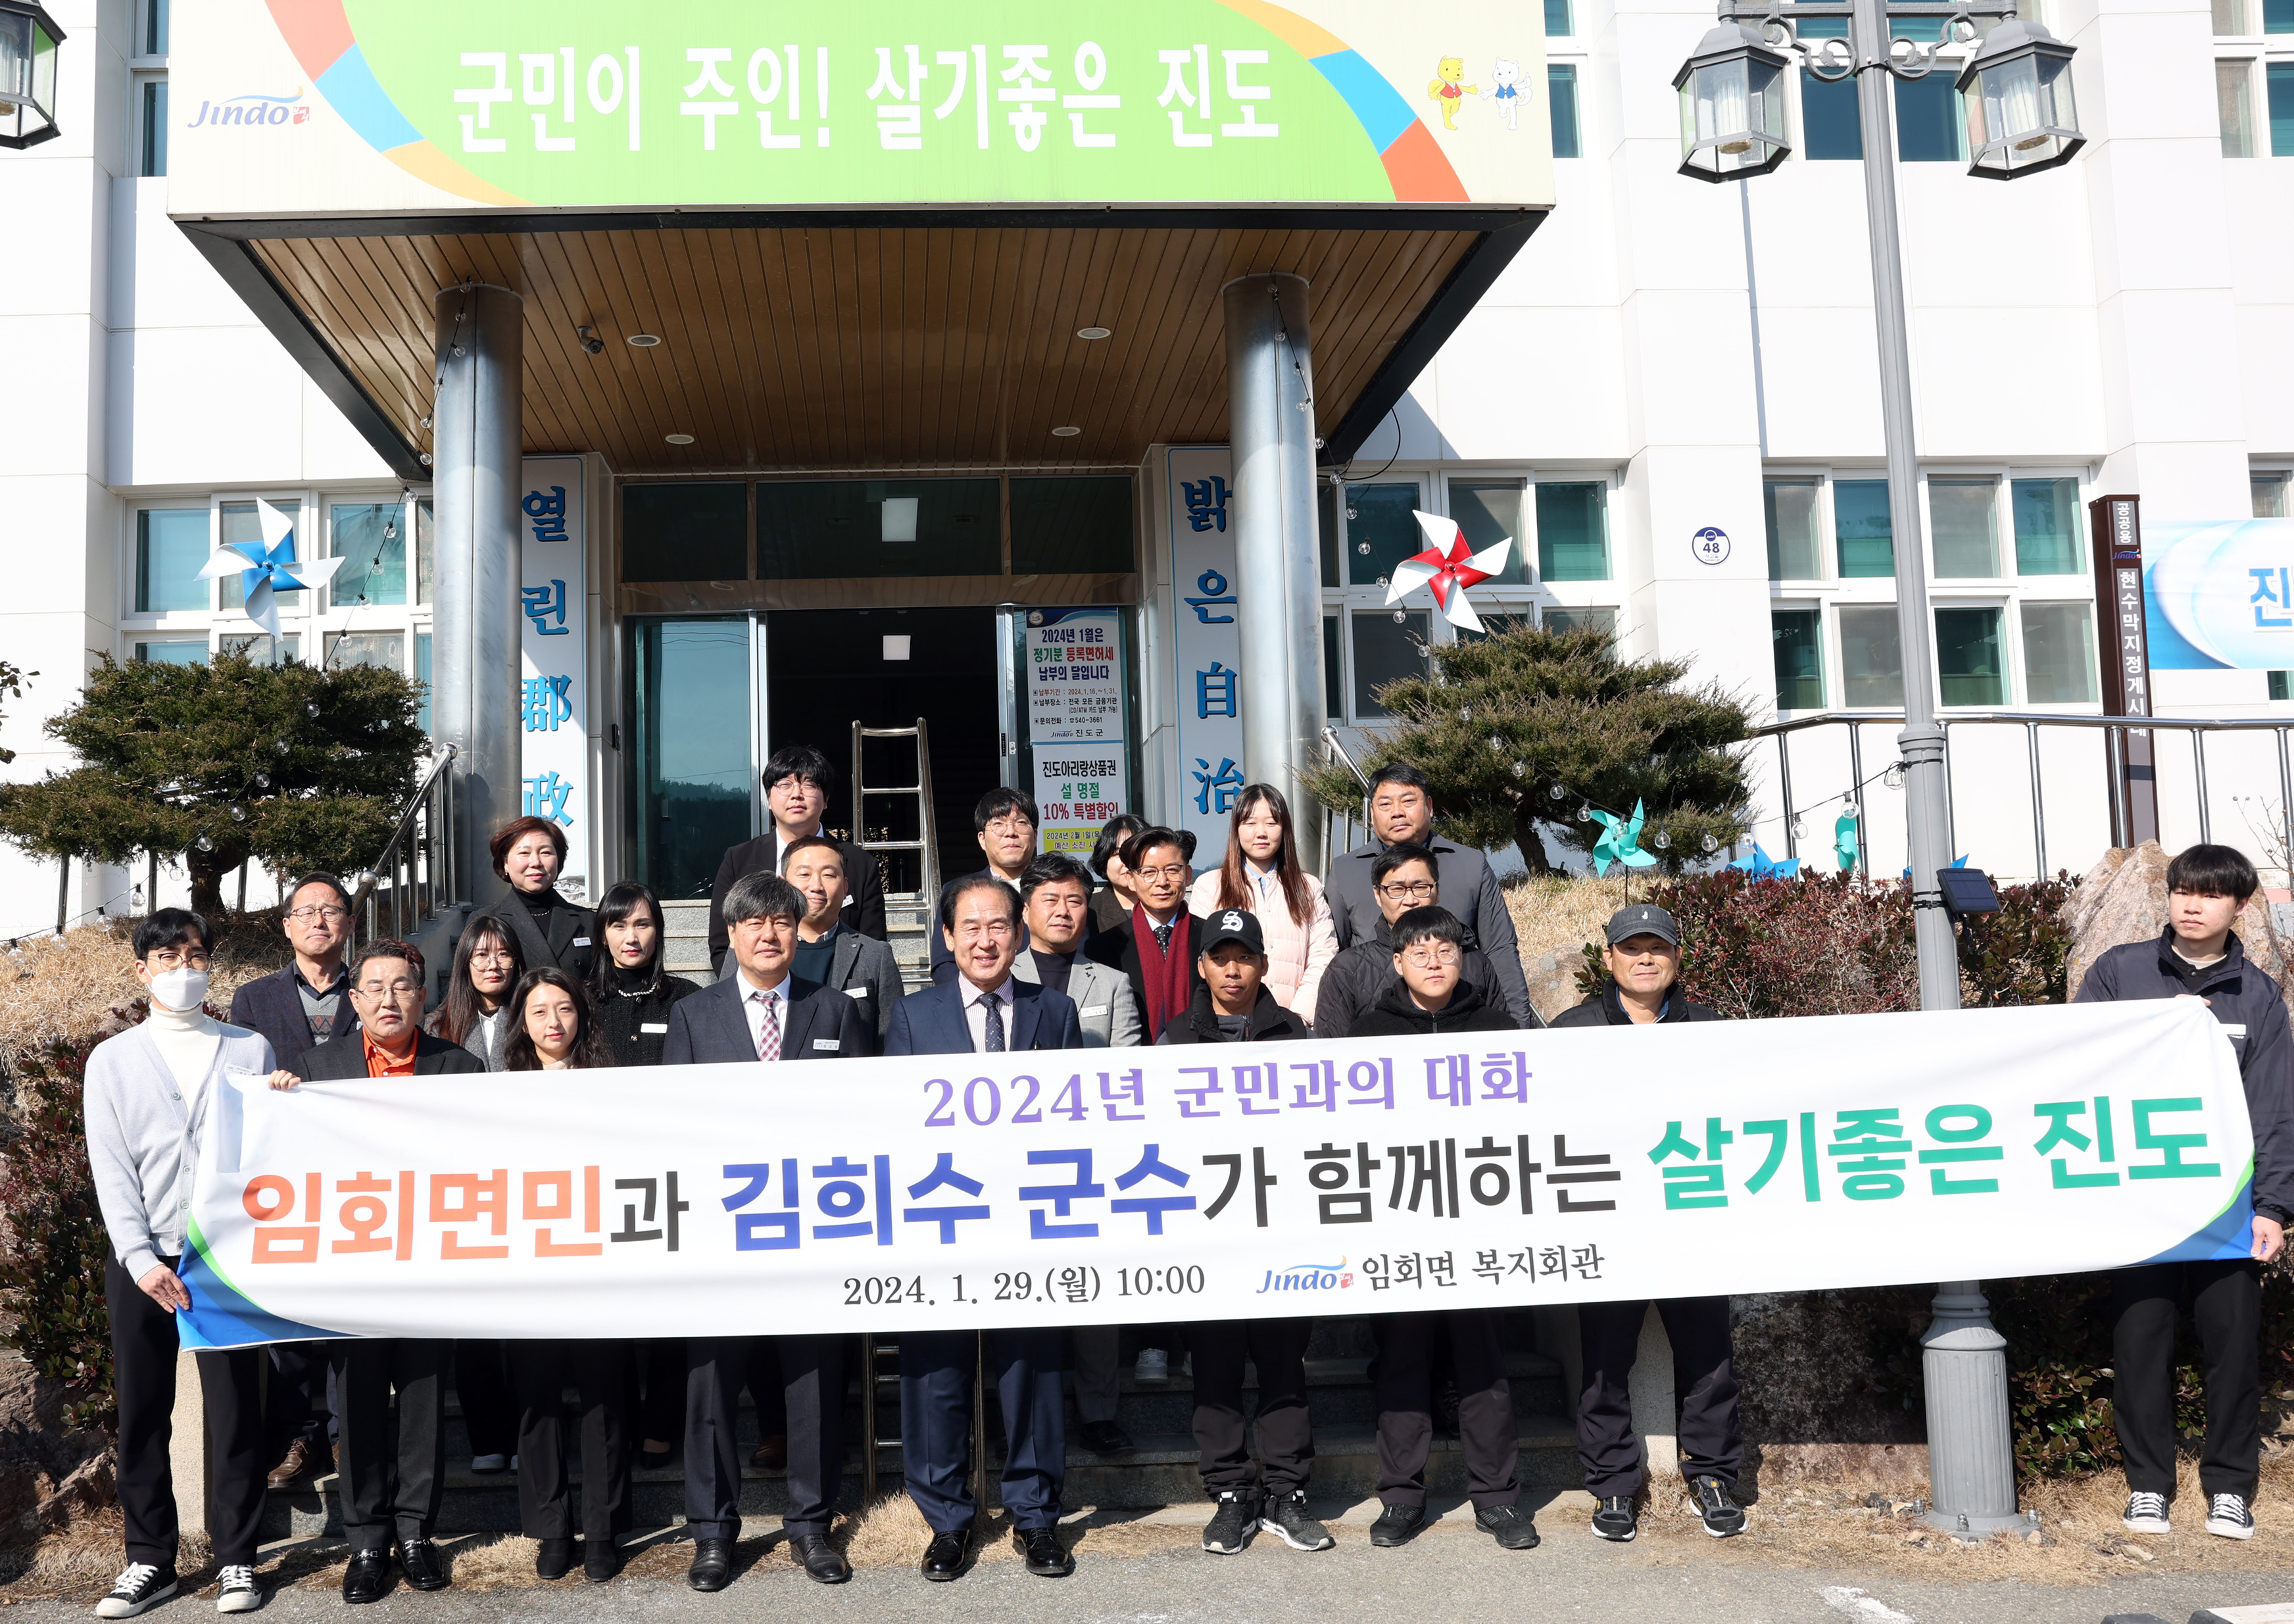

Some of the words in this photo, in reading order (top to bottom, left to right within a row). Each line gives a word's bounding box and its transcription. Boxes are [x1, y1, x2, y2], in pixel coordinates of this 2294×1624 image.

[454, 47, 641, 153] 군민이
[681, 45, 831, 151] 주인!
[866, 42, 1121, 153] 살기좋은
[1158, 45, 1279, 147] 진도
[187, 100, 289, 128] Jindo
[2117, 503, 2132, 544] 공공용
[1703, 543, 1720, 553] 48
[1042, 628, 1075, 643] 2024년
[1079, 627, 1104, 643] 1월은
[1033, 647, 1063, 663] 정기분
[1066, 647, 1114, 662] 등록면허세
[1038, 666, 1067, 681] 납부의
[1071, 665, 1110, 680] 달입니다
[1042, 760, 1116, 777] 진도아리랑상품권
[1061, 783, 1072, 799] 설
[1077, 782, 1100, 799] 명절
[1044, 803, 1069, 820] 10%
[1074, 802, 1118, 820] 특별할인
[1054, 841, 1069, 850] 예산
[925, 1070, 1145, 1127] 2024년
[1175, 1058, 1395, 1118] 군민과의
[1425, 1052, 1532, 1107] 대화
[243, 1166, 690, 1264] 임회면민과
[722, 1154, 990, 1252] 김희수
[1019, 1144, 1278, 1240] 군수가
[1305, 1135, 1621, 1225] 함께하는
[1648, 1105, 2004, 1210] 살기좋은
[2034, 1097, 2222, 1189] 진도
[1363, 1252, 1457, 1291] 임회면
[1473, 1244, 1605, 1285] 복지회관
[845, 1276, 935, 1306] 2024.
[954, 1275, 978, 1304] 1.
[1119, 1266, 1205, 1296] 10:00
[1256, 1269, 1338, 1294] Jindo
